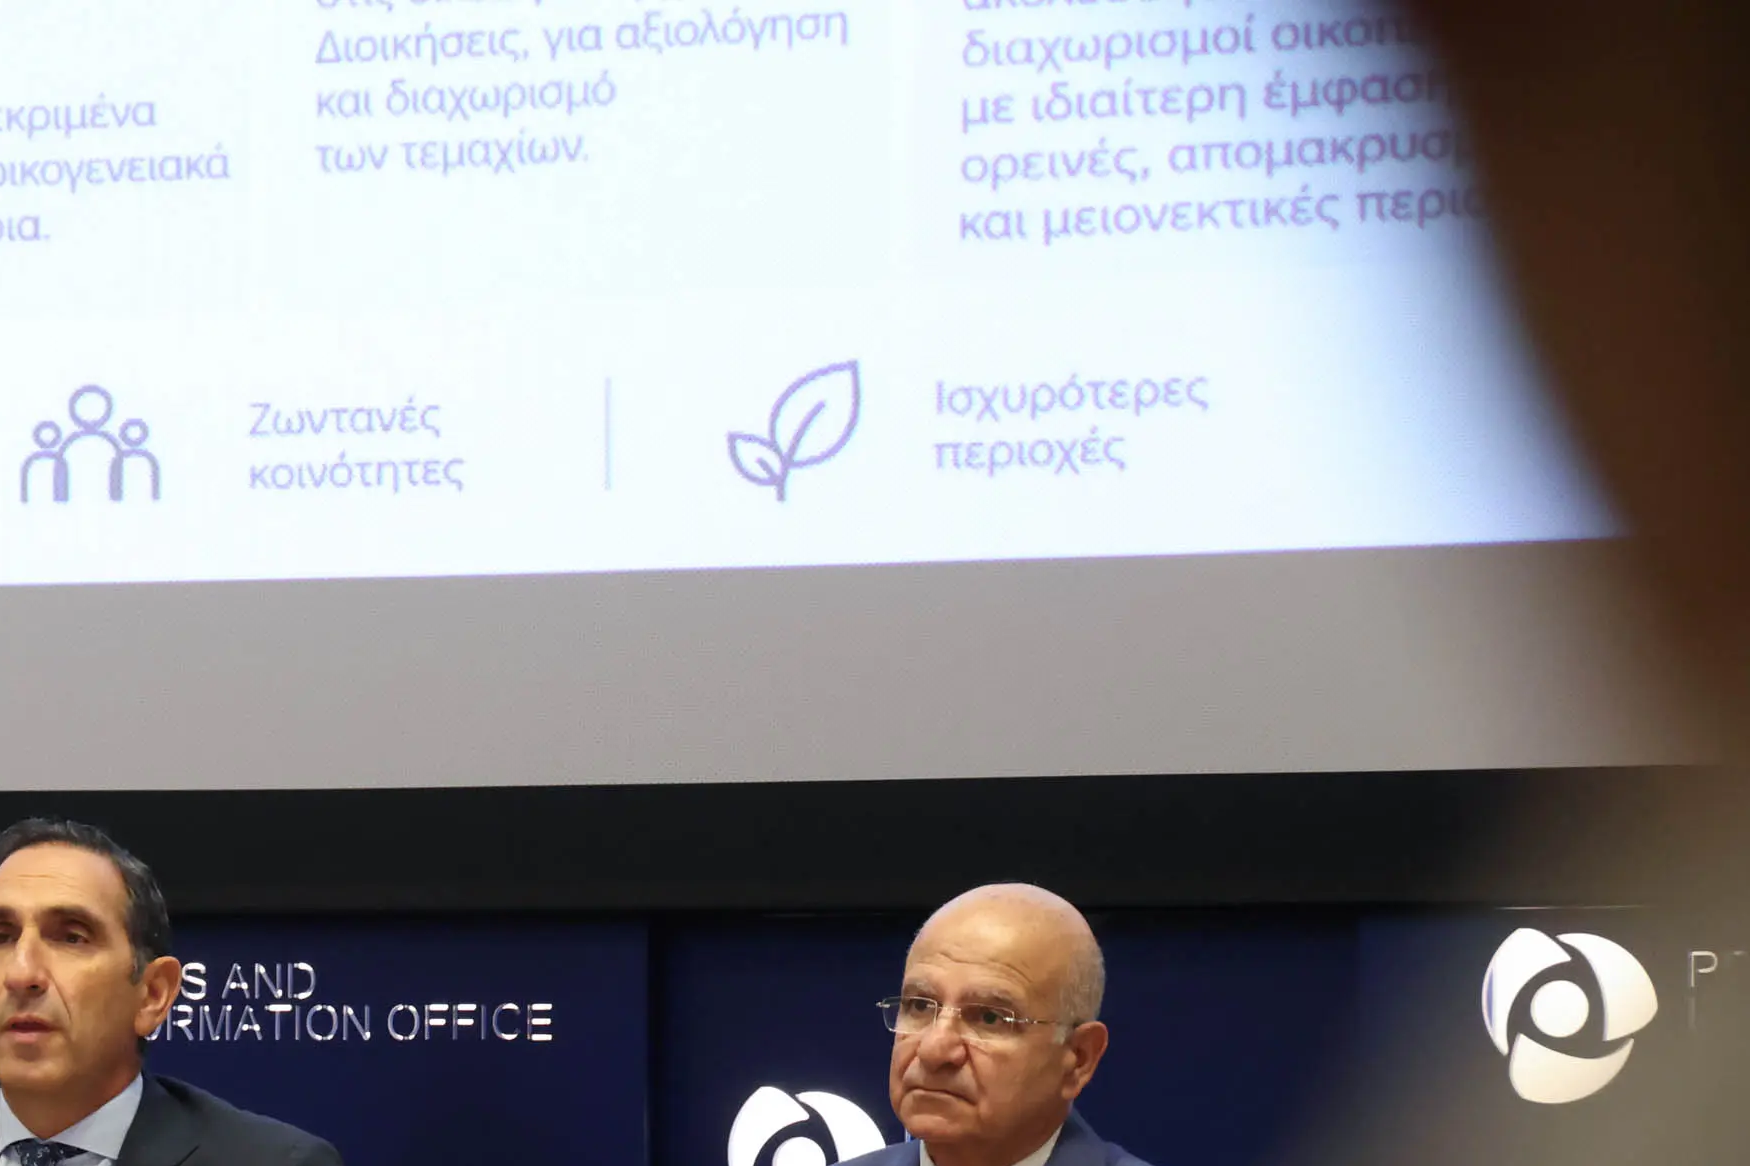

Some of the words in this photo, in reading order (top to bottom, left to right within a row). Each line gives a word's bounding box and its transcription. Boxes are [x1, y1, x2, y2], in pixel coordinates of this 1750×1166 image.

[314, 22, 531, 66] Διοικήσεις,
[542, 22, 603, 58] για
[615, 5, 850, 52] αξιολόγηση
[961, 13, 1256, 75] διαχωρισμοί
[1270, 14, 1415, 54] οικοπ
[315, 87, 372, 119] και
[385, 69, 617, 122] διαχωρισμό
[961, 94, 1015, 134] με
[1031, 78, 1248, 123] ιδιαίτερη
[316, 143, 388, 174] των
[401, 130, 590, 177] τεμαχίων.
[960, 138, 1151, 191] ορεινές,
[1167, 128, 1468, 179] απομακρυσ
[959, 208, 1028, 243] και
[1042, 184, 1340, 247] μειονεκτικές
[1356, 186, 1488, 230] περιο
[248, 396, 442, 440] Ζωντανές
[935, 373, 1210, 423] Ισχυρότερες
[249, 449, 464, 493] κοινότητες
[934, 427, 1127, 478] περιοχές
[221, 961, 317, 1000] AND
[144, 1002, 372, 1042] RMATION
[387, 1002, 553, 1042] OFFICE
